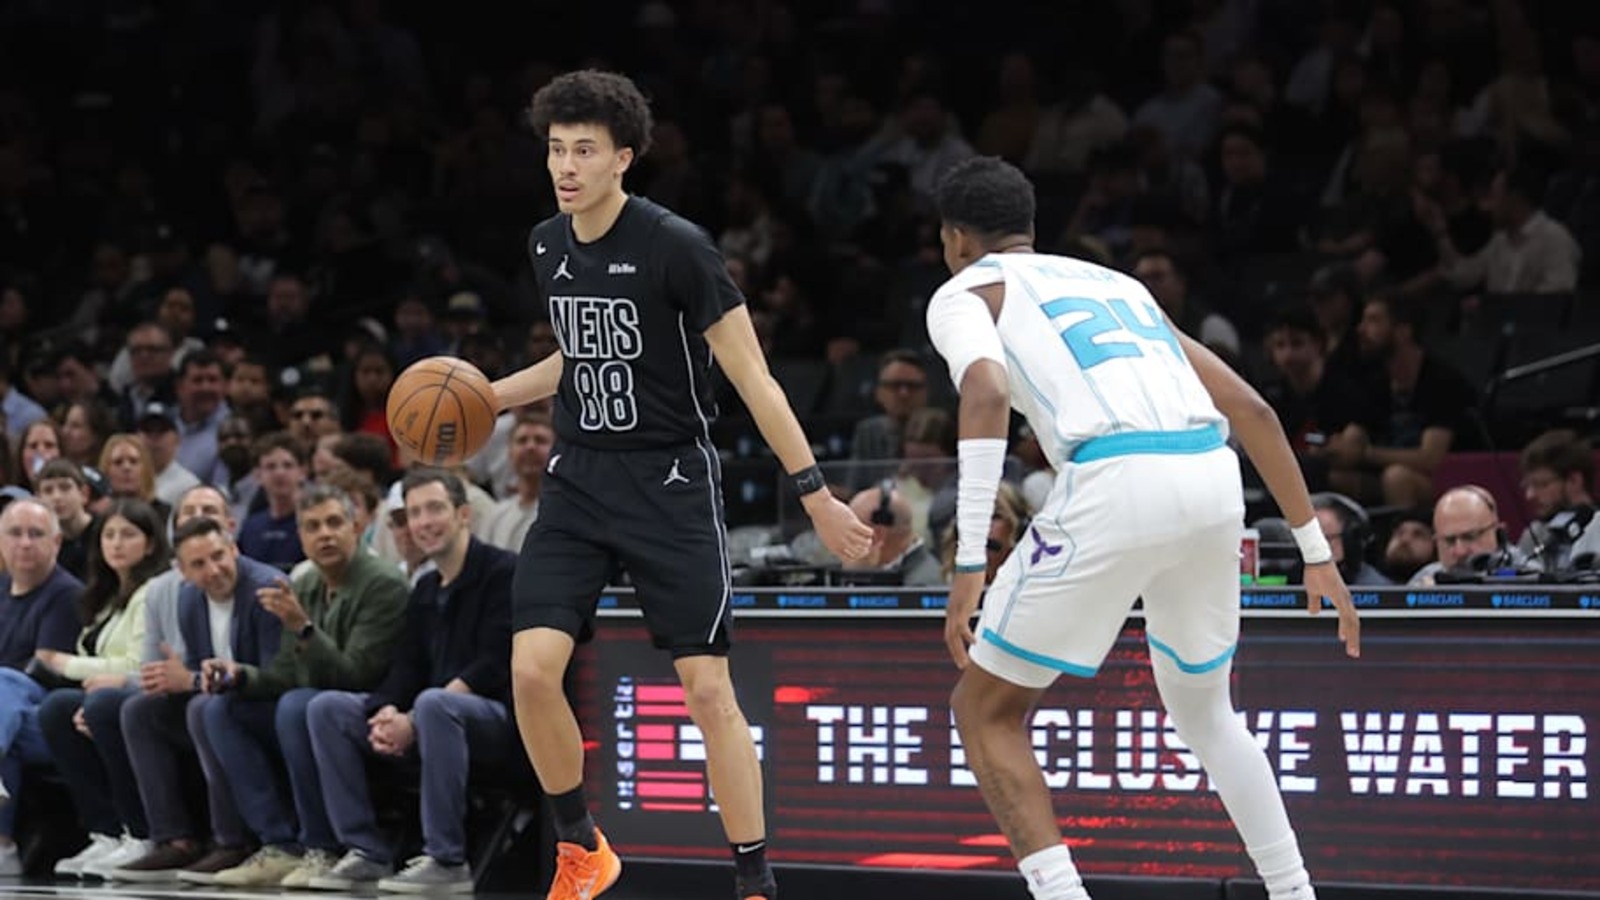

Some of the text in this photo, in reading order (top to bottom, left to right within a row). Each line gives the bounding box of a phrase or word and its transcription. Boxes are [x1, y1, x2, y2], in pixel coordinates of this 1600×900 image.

[549, 296, 643, 360] NETS
[1040, 297, 1185, 370] 24
[574, 361, 638, 431] 88
[1417, 594, 1465, 605] BARCLAYS
[1501, 595, 1551, 607] BARCLAYS
[806, 706, 1588, 798] THE CLUSE WATER
